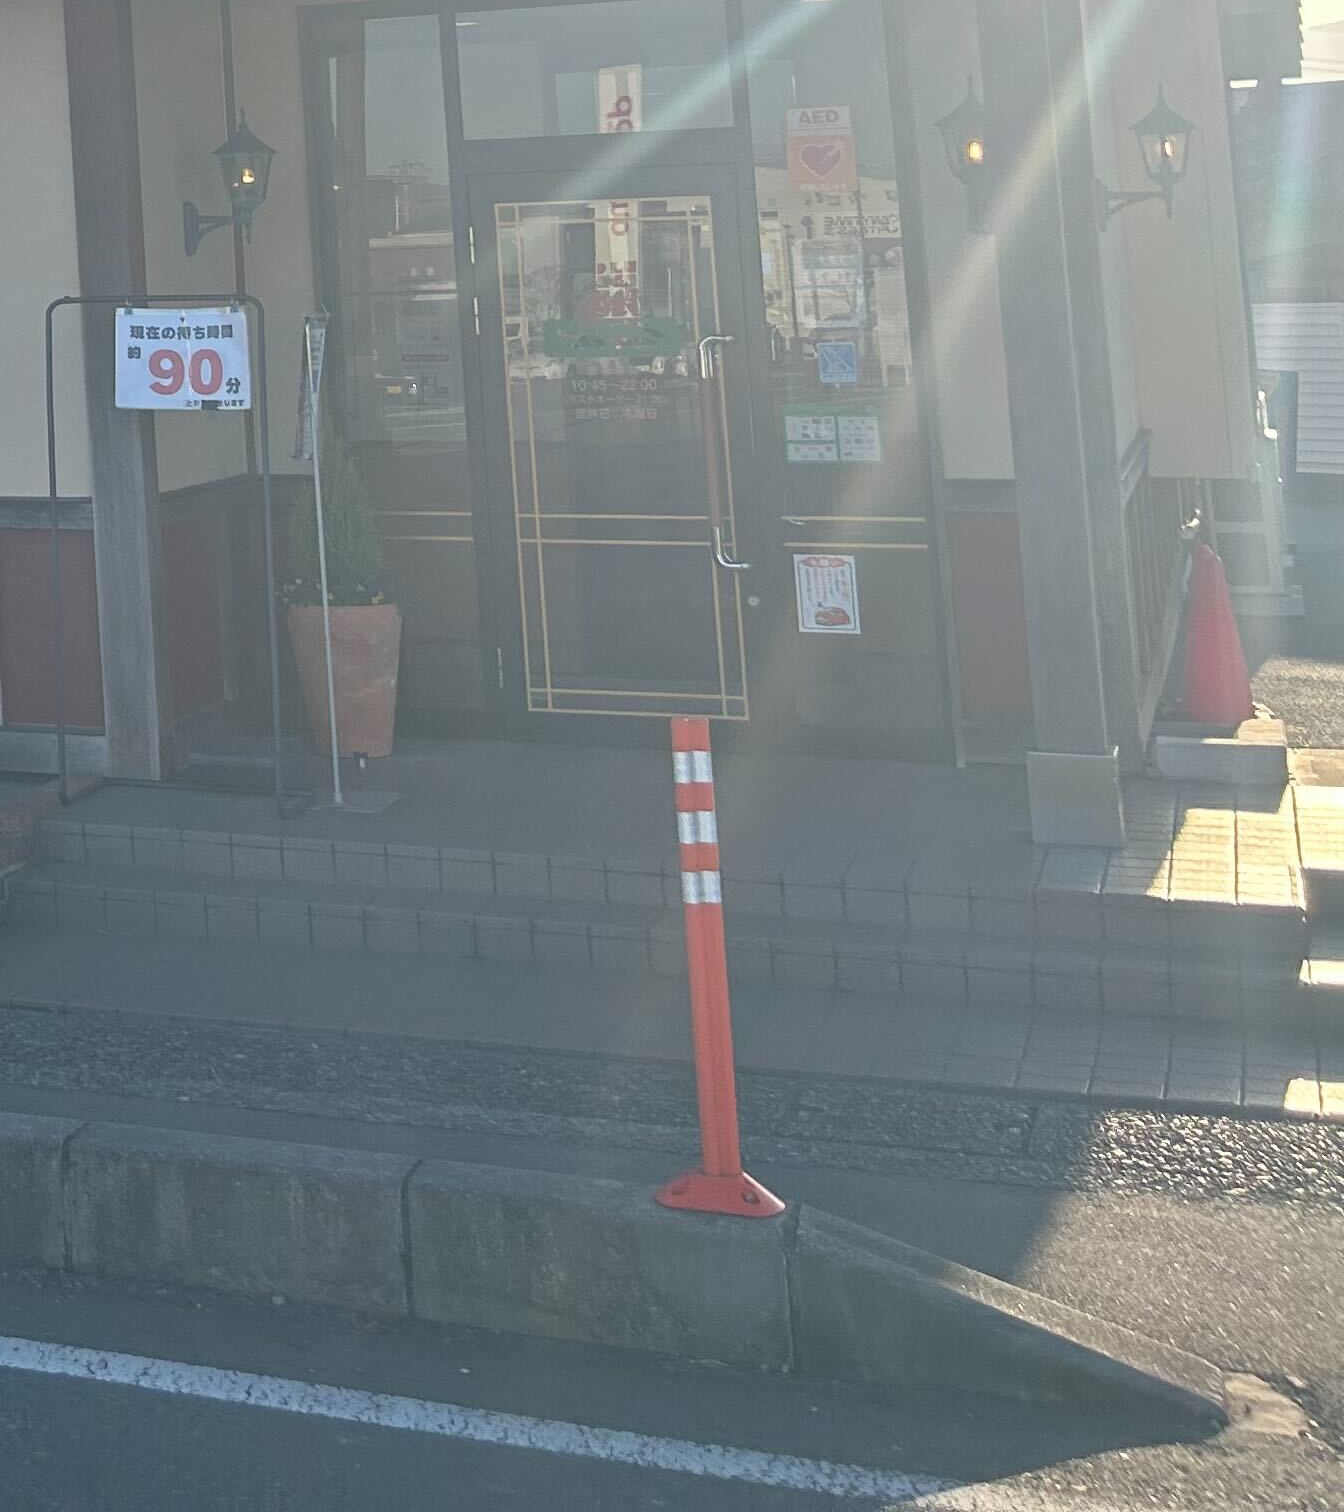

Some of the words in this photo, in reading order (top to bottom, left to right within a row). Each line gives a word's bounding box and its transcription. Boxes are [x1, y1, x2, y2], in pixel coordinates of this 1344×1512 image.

[798, 109, 840, 125] AED
[129, 324, 233, 340] 現在の待ち時間
[127, 345, 141, 359] 約
[148, 348, 223, 396] 90
[226, 377, 241, 394] 分
